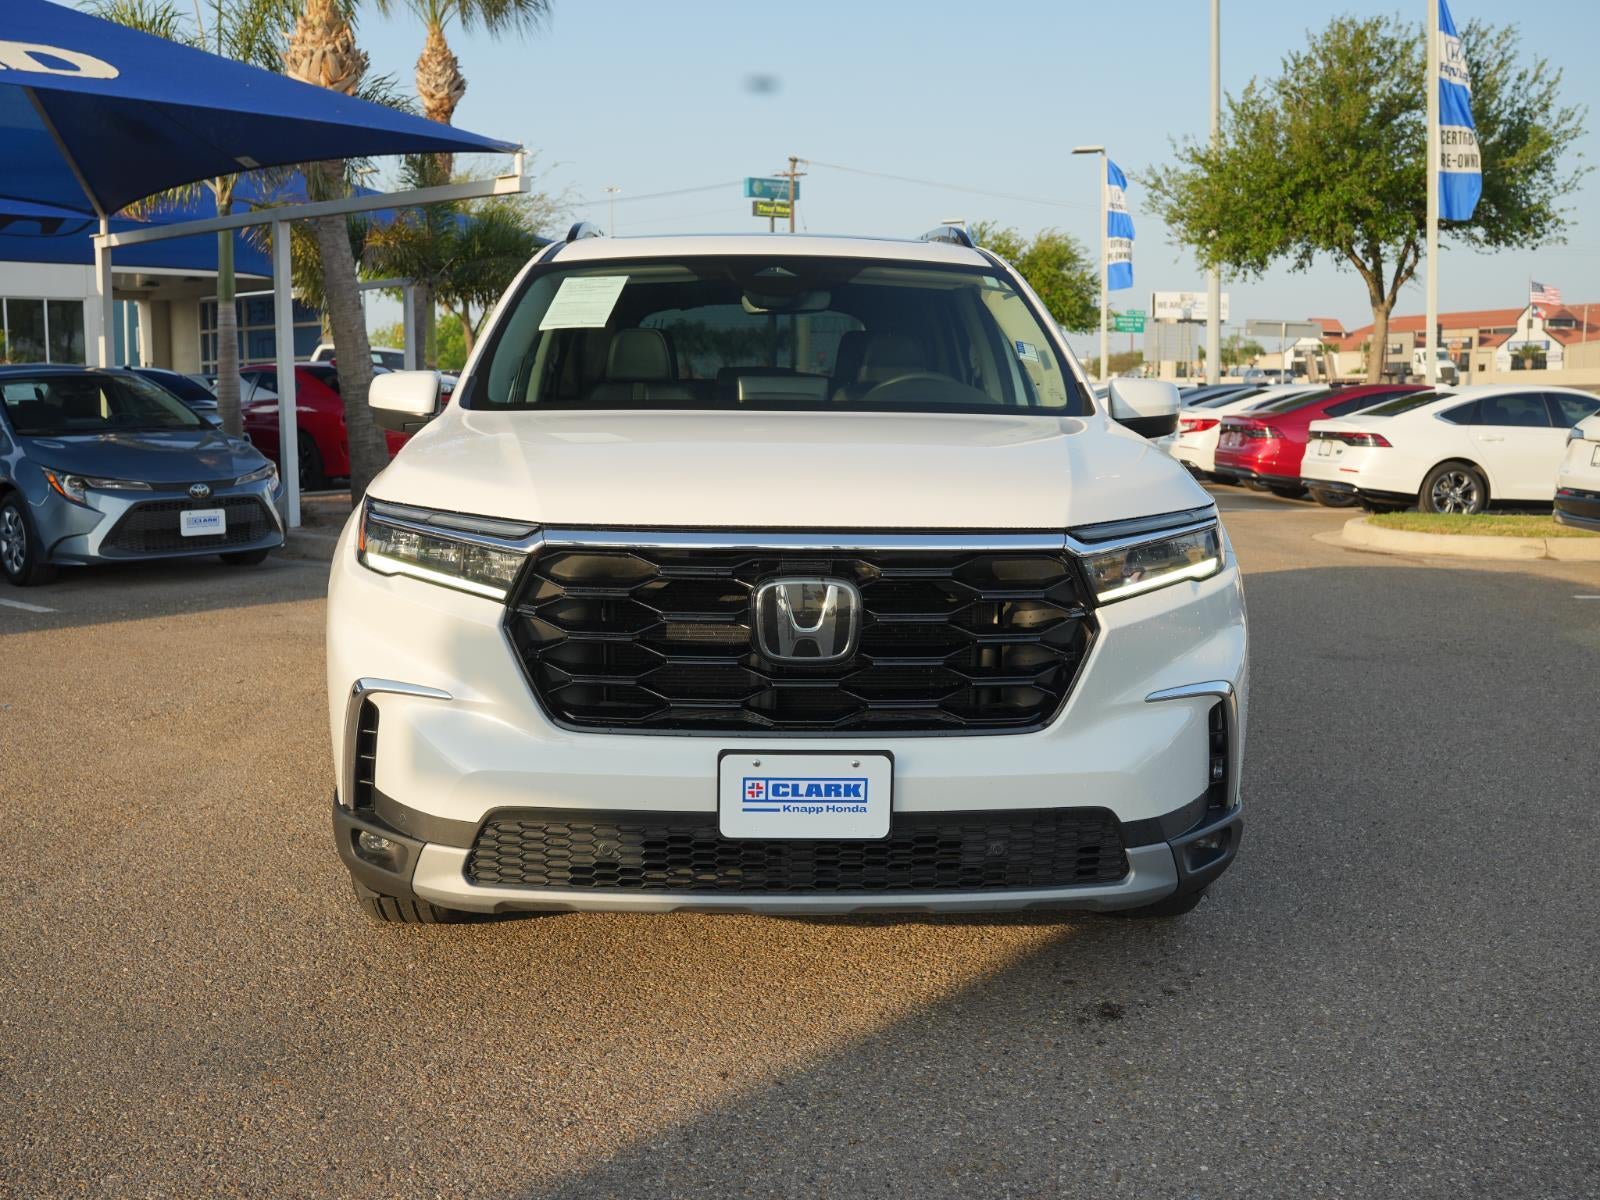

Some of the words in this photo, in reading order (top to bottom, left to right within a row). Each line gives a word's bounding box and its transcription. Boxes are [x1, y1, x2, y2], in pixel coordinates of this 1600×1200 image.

[771, 783, 862, 798] CLARK
[782, 804, 824, 815] Knapp
[826, 804, 867, 813] Honda
